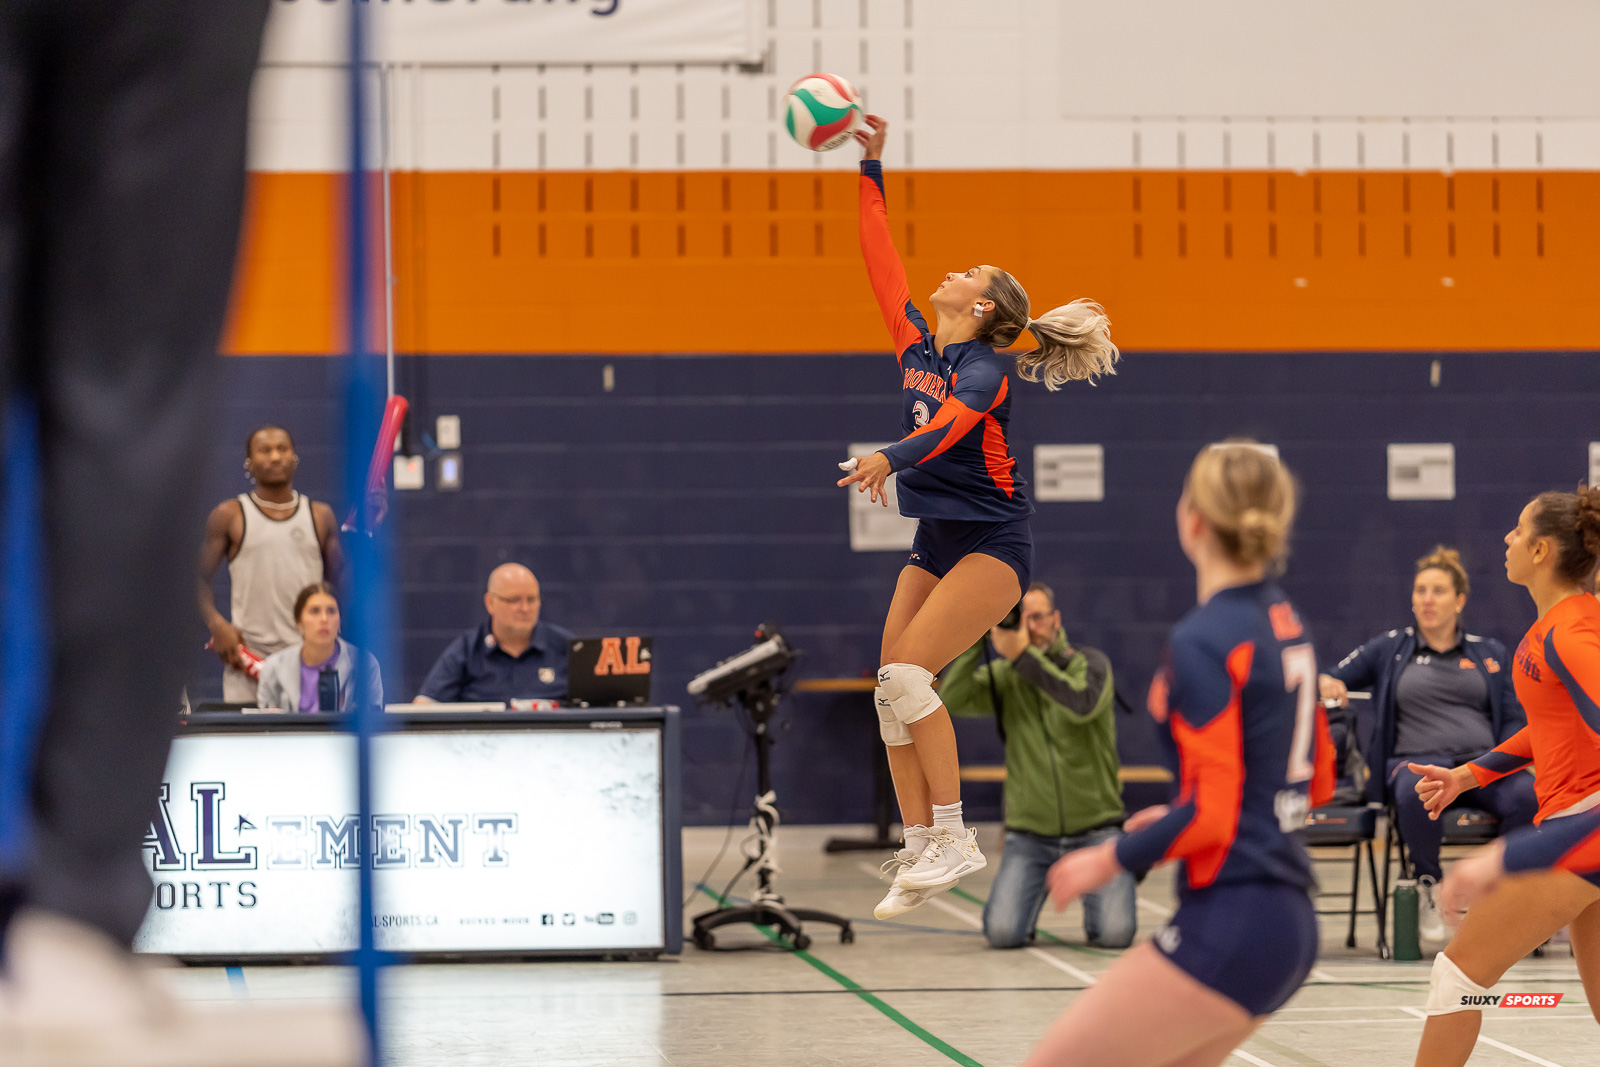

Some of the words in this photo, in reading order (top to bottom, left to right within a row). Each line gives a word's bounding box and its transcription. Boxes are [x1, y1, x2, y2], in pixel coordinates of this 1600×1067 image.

[594, 636, 651, 676] AL
[1281, 642, 1317, 785] 7
[266, 813, 519, 871] EMENT
[155, 881, 258, 910] ORTS
[371, 914, 440, 928] L-SPORTS.CA
